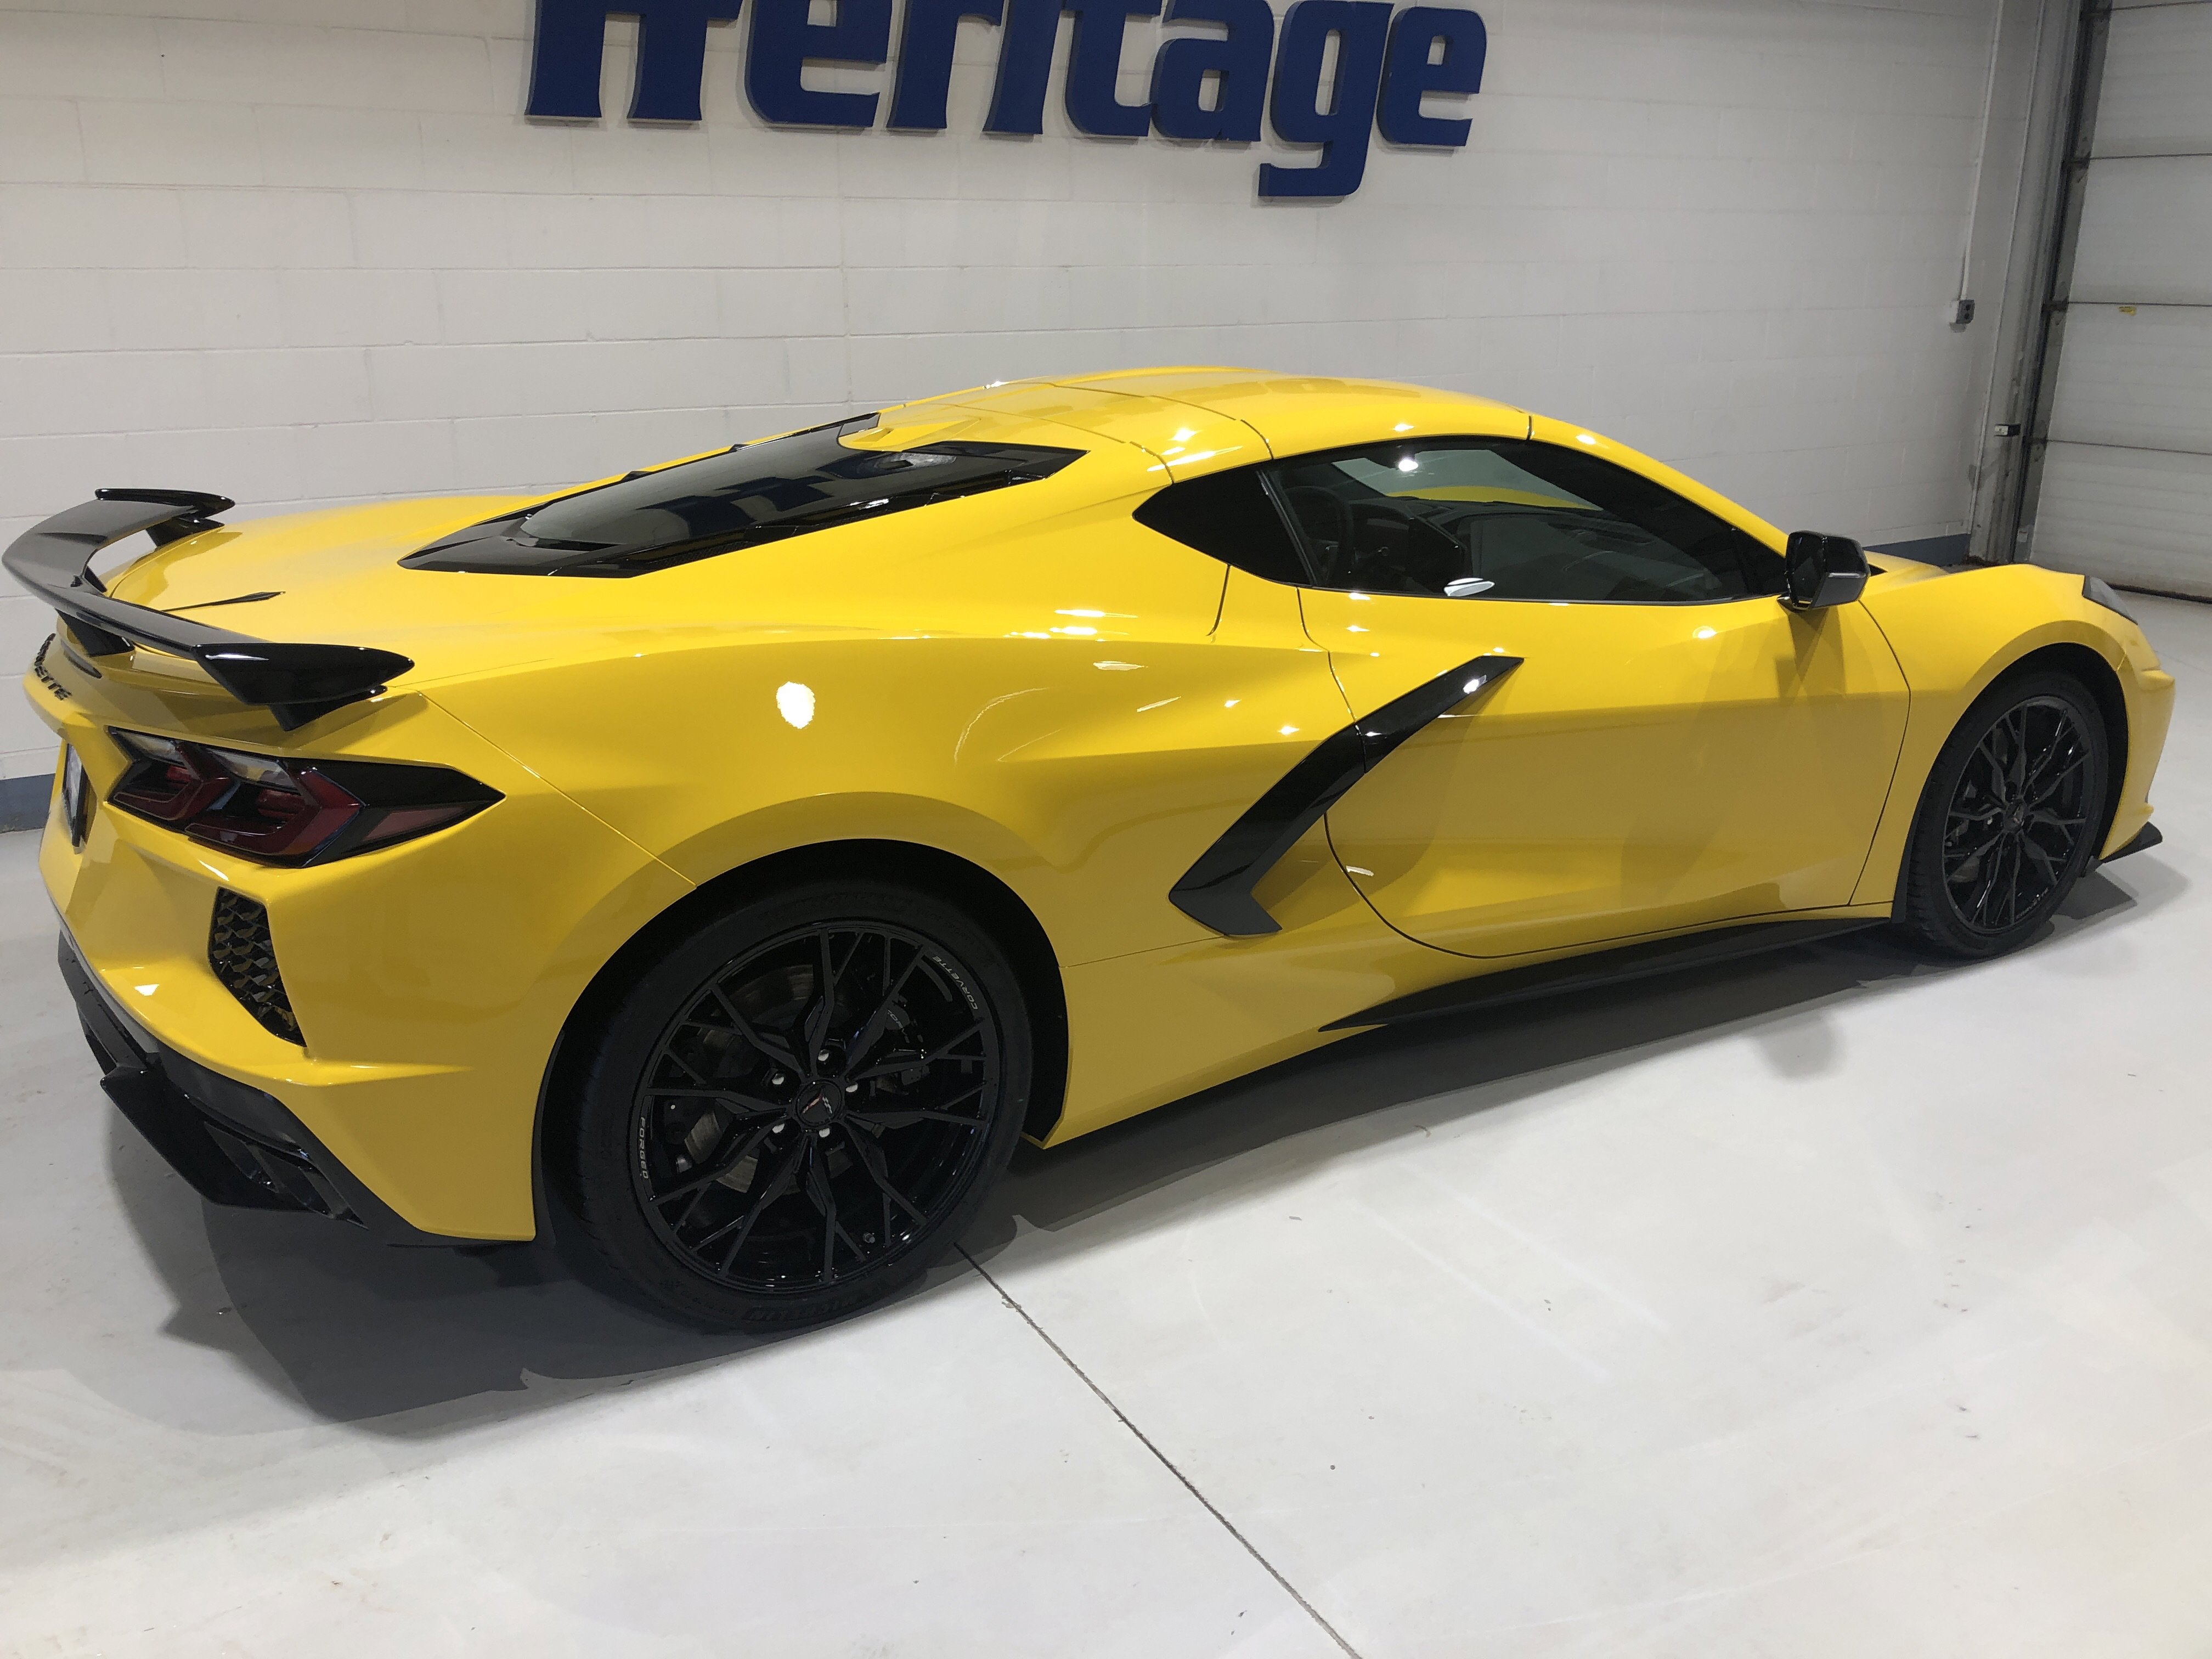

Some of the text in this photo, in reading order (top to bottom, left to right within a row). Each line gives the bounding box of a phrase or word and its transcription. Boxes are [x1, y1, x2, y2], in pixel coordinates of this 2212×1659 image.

[34, 633, 72, 701] ETTE
[932, 956, 978, 1009] CORVETTE
[639, 1117, 648, 1179] FORGED
